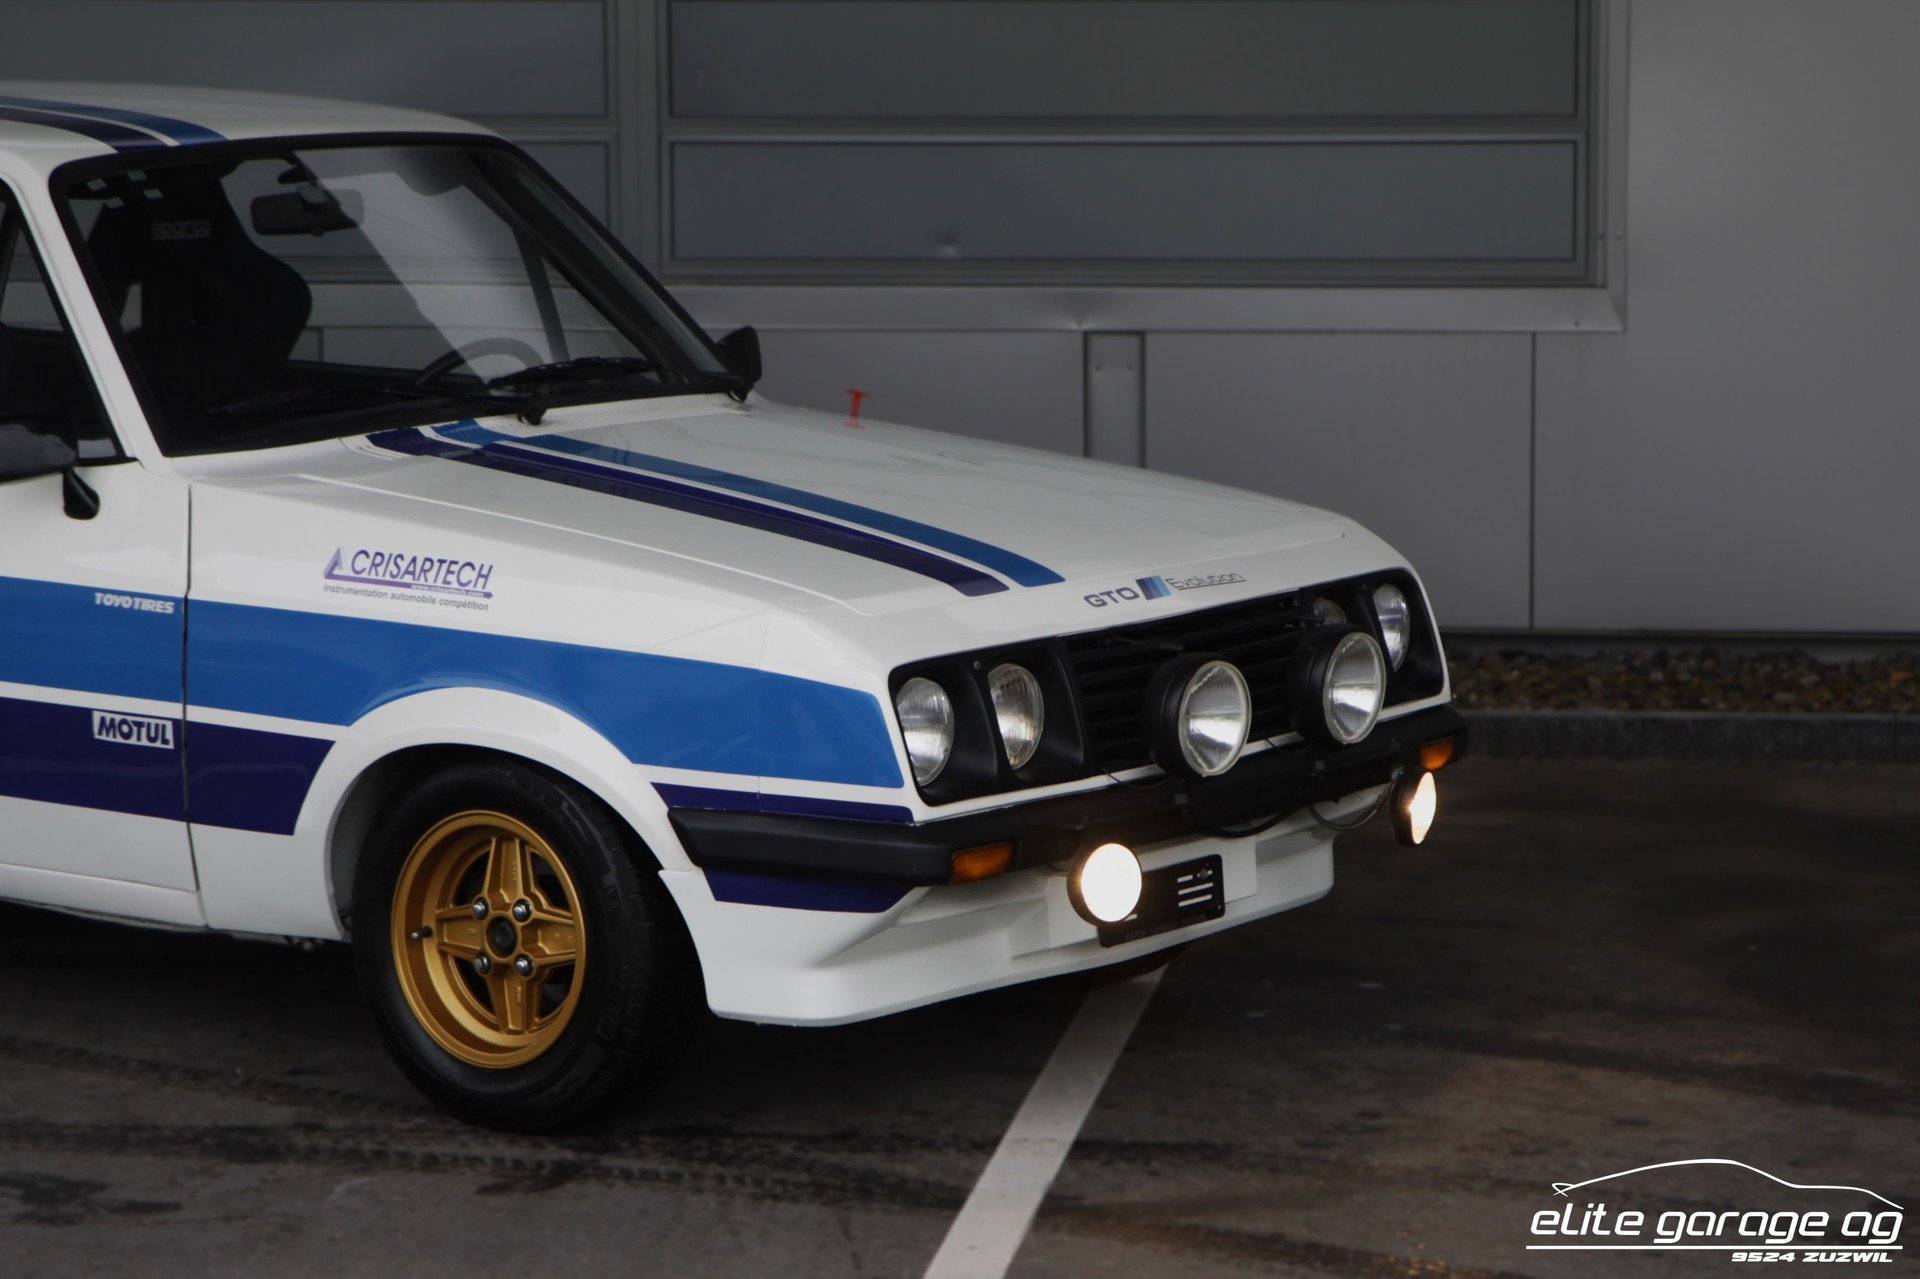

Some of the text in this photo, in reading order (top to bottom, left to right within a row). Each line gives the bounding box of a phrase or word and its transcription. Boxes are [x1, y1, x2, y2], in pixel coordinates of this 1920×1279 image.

[351, 549, 493, 590] CRISARTECH
[1165, 572, 1244, 589] Evolution
[323, 584, 388, 600] instrumentation
[390, 591, 437, 605] automobile
[97, 715, 170, 746] MOTUL
